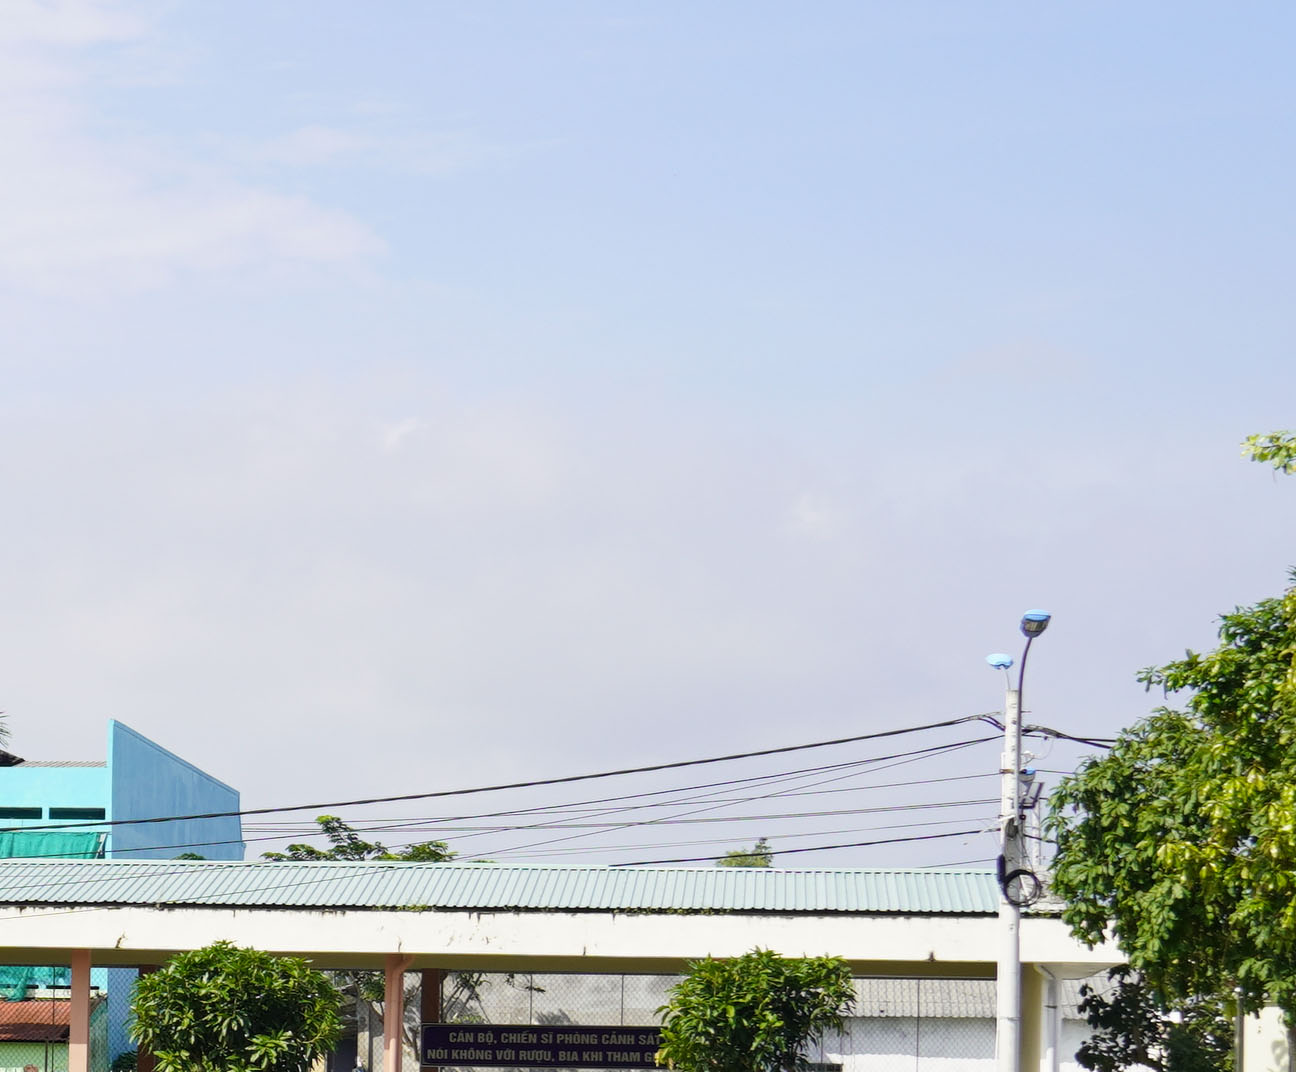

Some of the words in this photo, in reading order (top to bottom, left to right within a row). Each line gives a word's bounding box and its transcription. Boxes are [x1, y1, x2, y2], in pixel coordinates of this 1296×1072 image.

[448, 1031, 474, 1043] CÁN
[500, 1030, 537, 1044] CHIẾN
[556, 1032, 598, 1045] PHÒNG
[427, 1048, 448, 1060] NÓI
[451, 1048, 492, 1060] KHÔNG
[495, 1049, 515, 1061] VỚI
[558, 1051, 578, 1062] BIA
[582, 1051, 603, 1062] KHI
[606, 1052, 641, 1063] THAM
